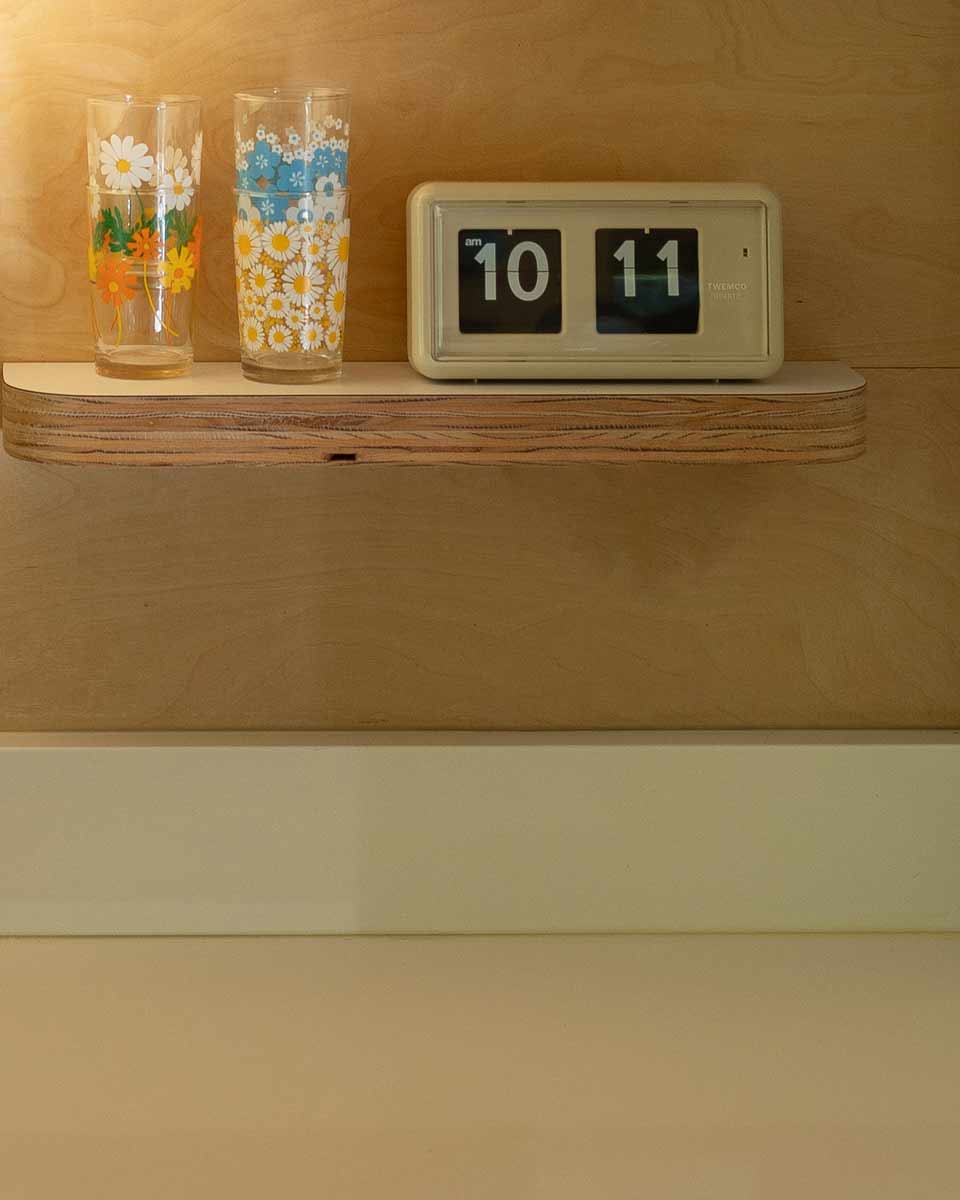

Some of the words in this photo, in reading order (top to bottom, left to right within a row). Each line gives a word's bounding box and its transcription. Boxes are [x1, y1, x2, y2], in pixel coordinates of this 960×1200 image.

[465, 238, 482, 247] am
[474, 241, 549, 301] 10
[613, 240, 680, 297] 11
